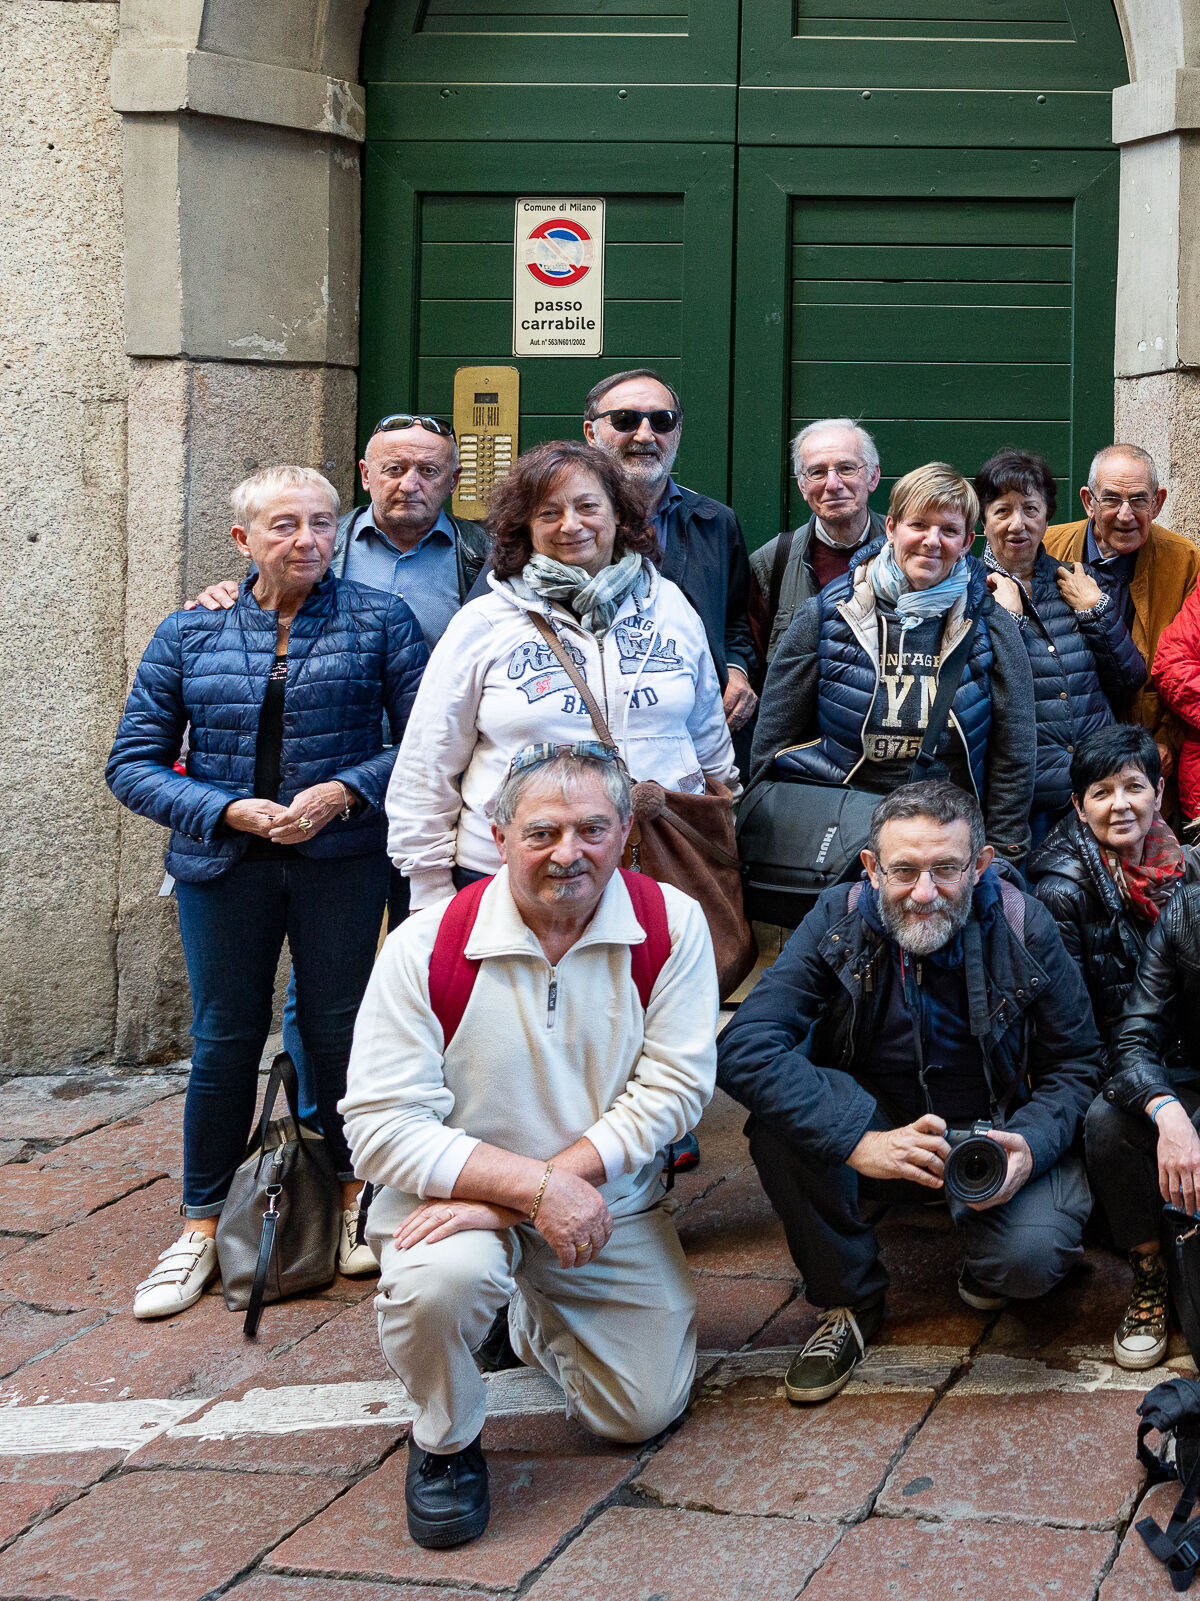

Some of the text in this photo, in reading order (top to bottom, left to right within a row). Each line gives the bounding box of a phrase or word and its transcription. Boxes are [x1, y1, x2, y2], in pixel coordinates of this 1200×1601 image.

[523, 203, 597, 212] Comune di Milano
[534, 301, 583, 314] passo
[521, 316, 596, 330] carrabile
[815, 826, 838, 864] THULE
